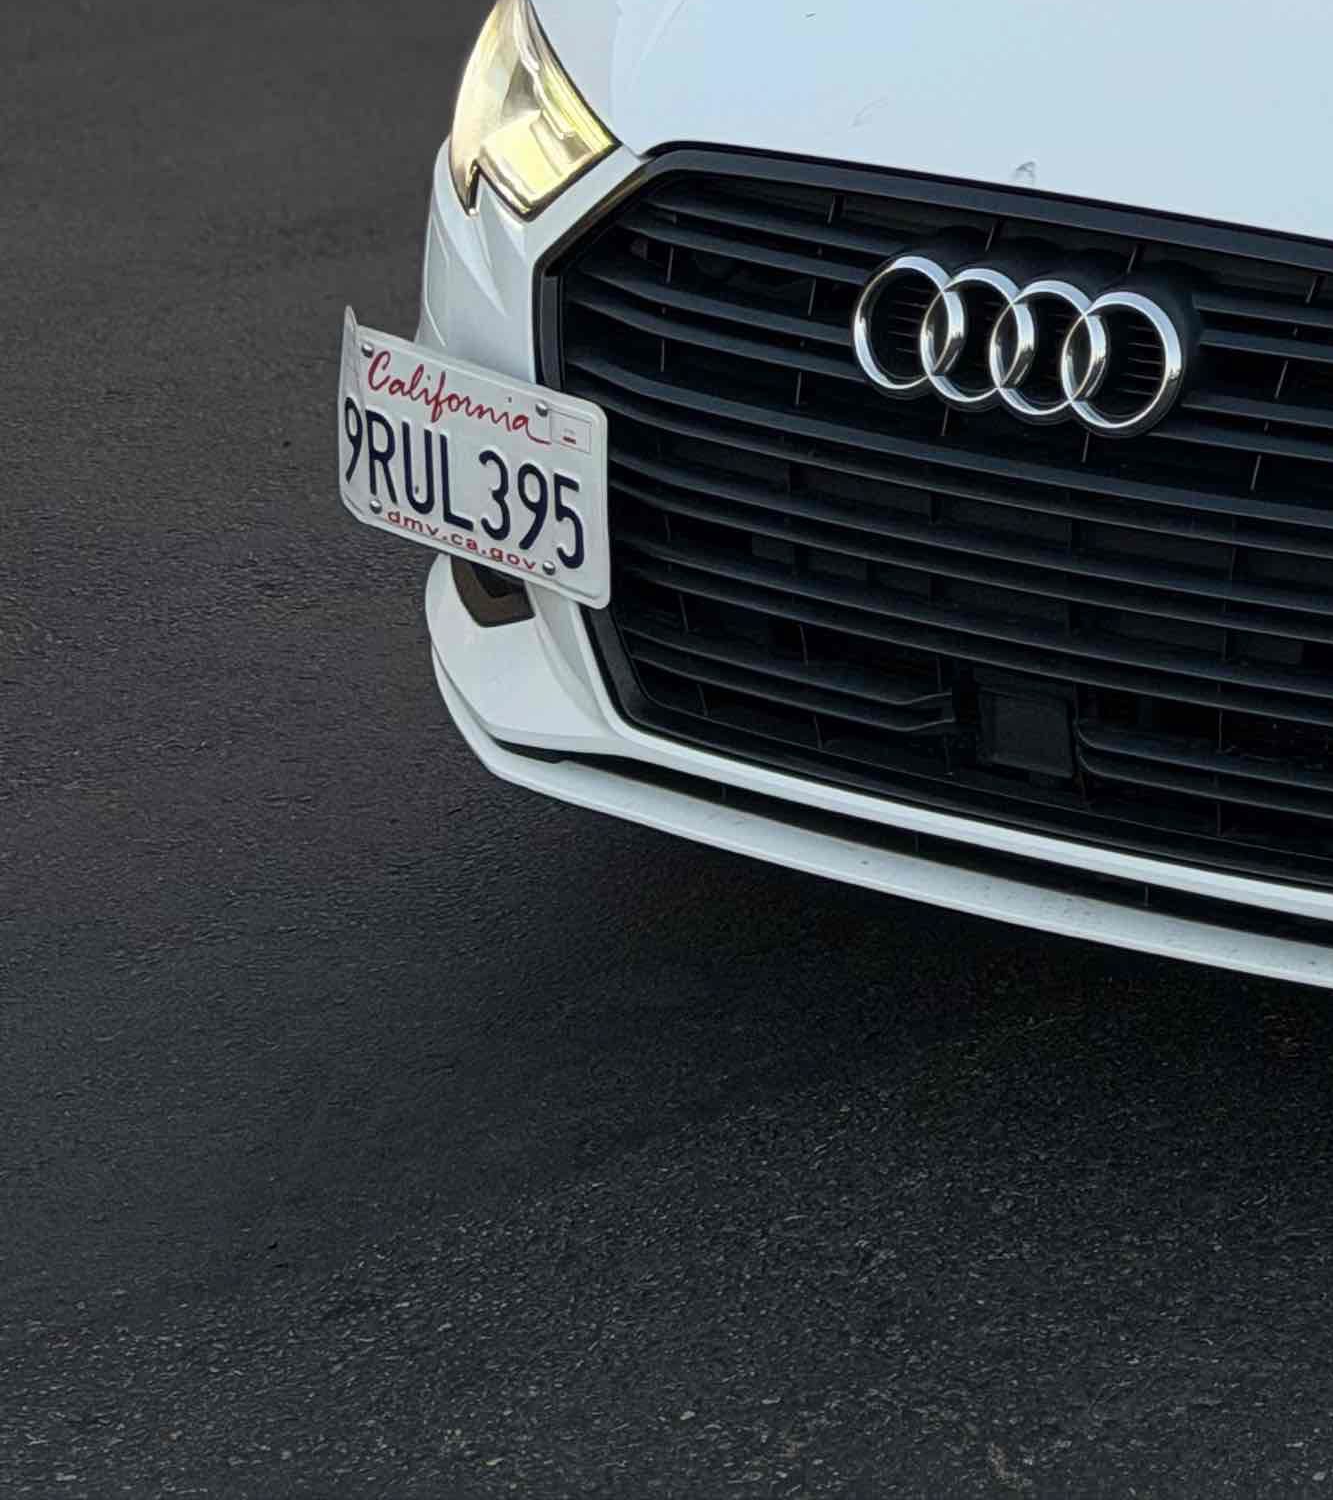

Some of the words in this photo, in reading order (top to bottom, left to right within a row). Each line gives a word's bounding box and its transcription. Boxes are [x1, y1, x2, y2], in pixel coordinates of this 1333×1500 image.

[367, 351, 552, 445] California
[344, 396, 585, 570] 9RUL395
[387, 509, 537, 571] dmv.ca.gov
